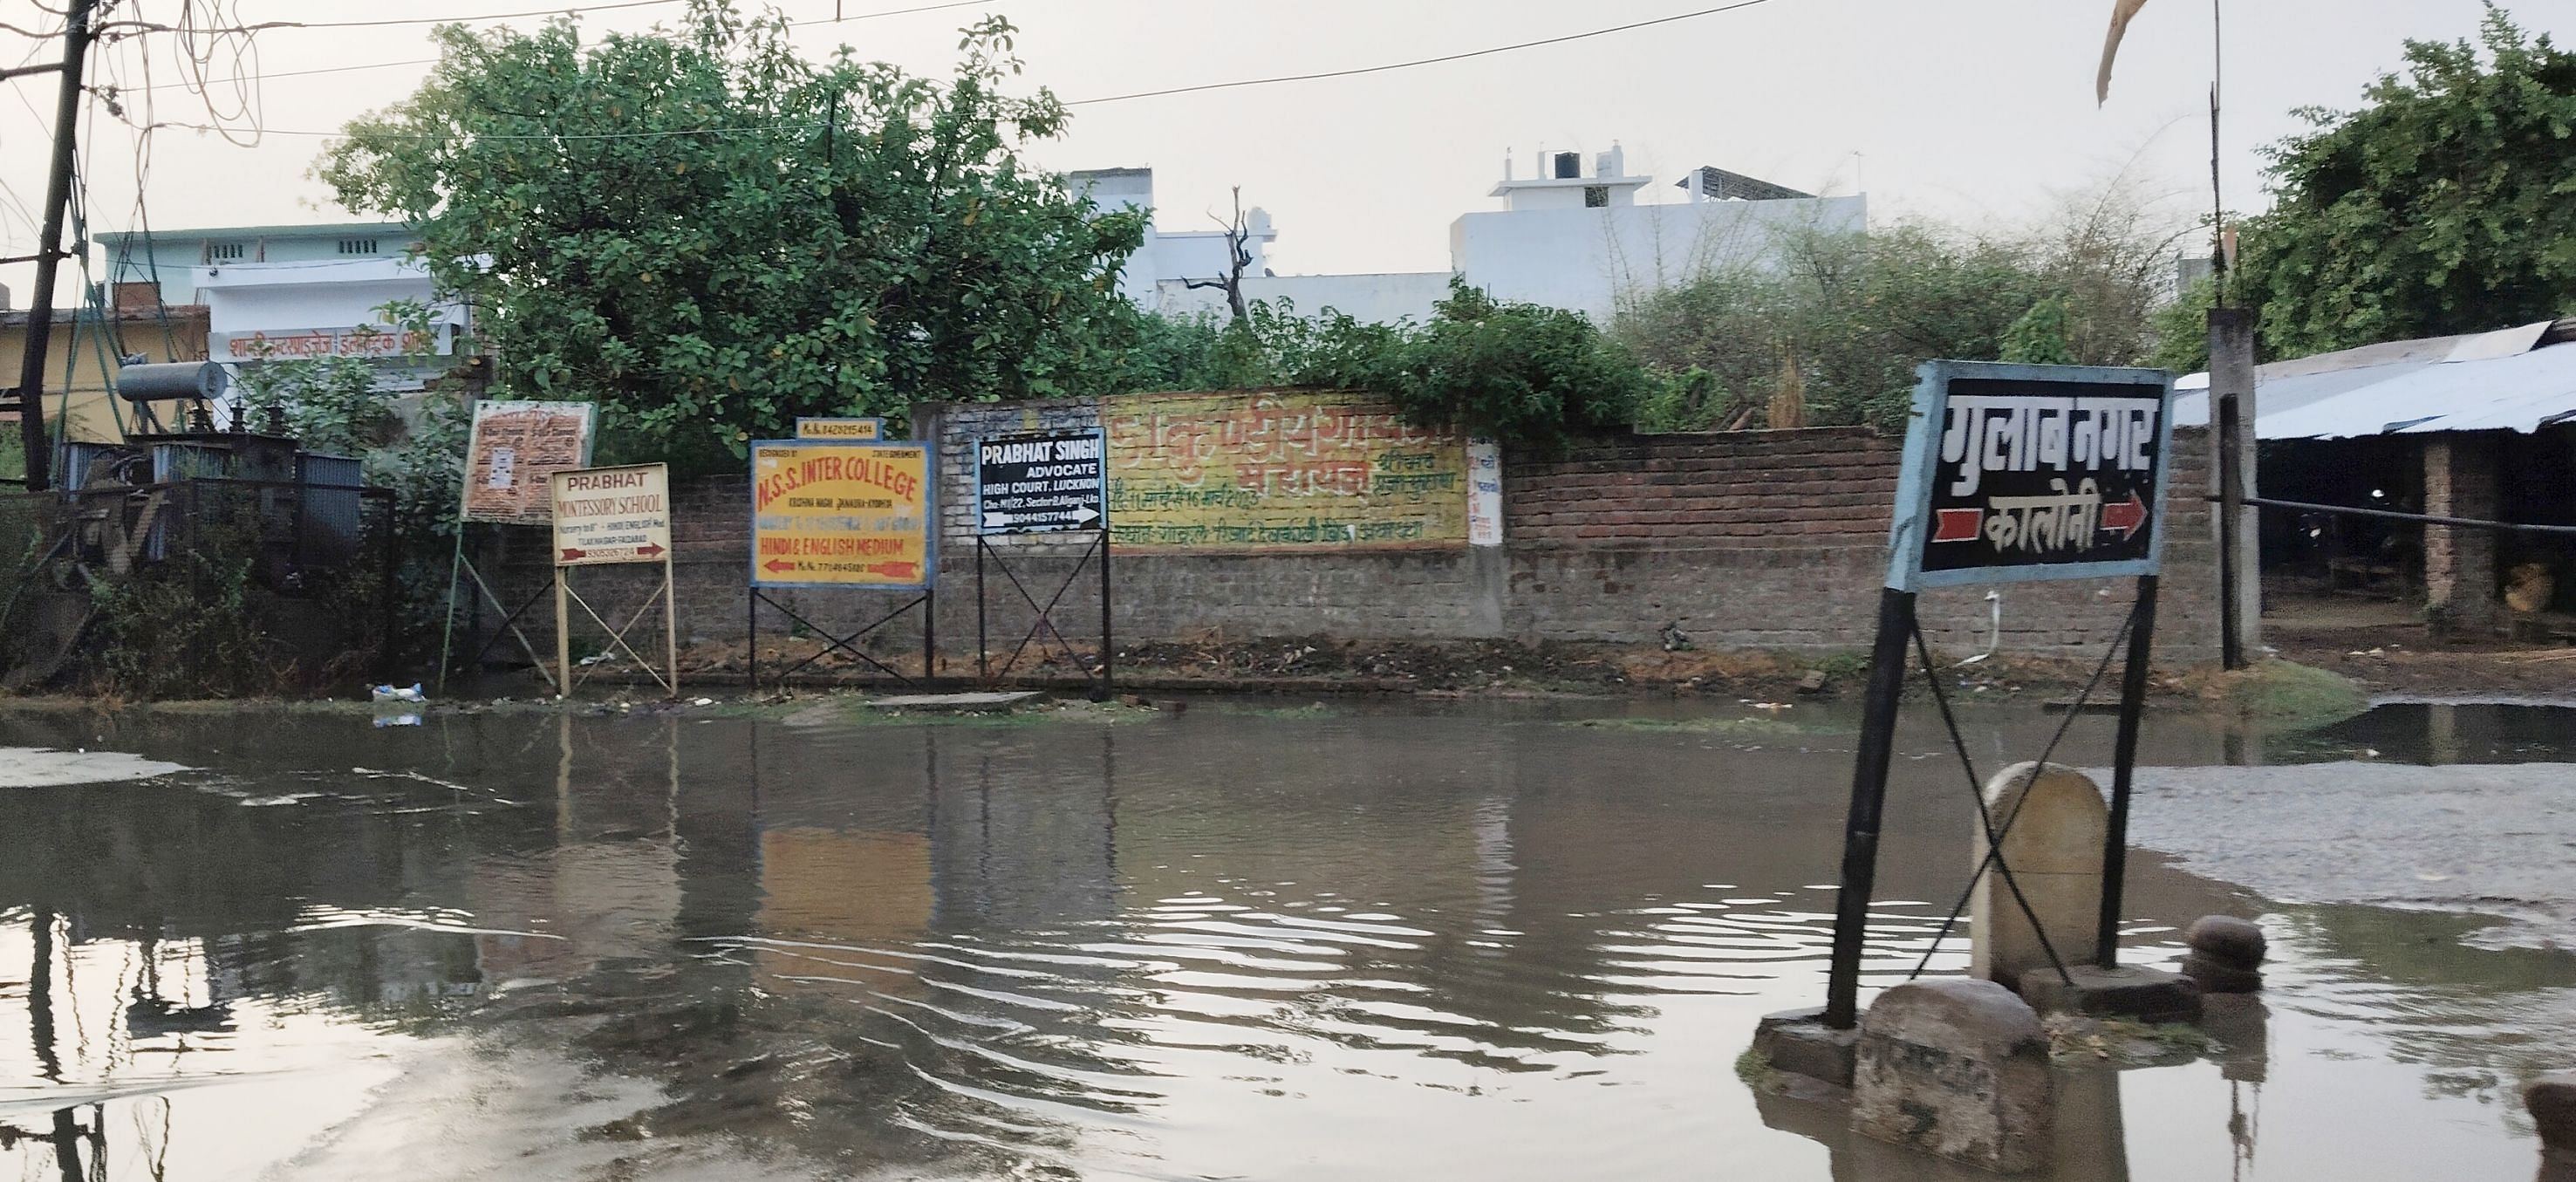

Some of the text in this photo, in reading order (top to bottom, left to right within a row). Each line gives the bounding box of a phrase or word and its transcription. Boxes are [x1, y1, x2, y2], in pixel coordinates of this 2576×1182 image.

[981, 438, 1099, 465] PRABHAT SINGH
[801, 455, 843, 487] INTER
[845, 455, 918, 503] COLLEGE
[1026, 463, 1097, 479] ADVOCATE
[567, 472, 649, 491] PRABHAT
[982, 482, 1008, 495] HIGH
[1054, 478, 1100, 491] LUCKNOW
[618, 494, 663, 515] SCHOOL
[1985, 477, 2101, 553] कालोनी
[761, 537, 792, 556] HINDI
[803, 537, 854, 556] ENGLISH
[857, 537, 904, 557] MEDIUM
